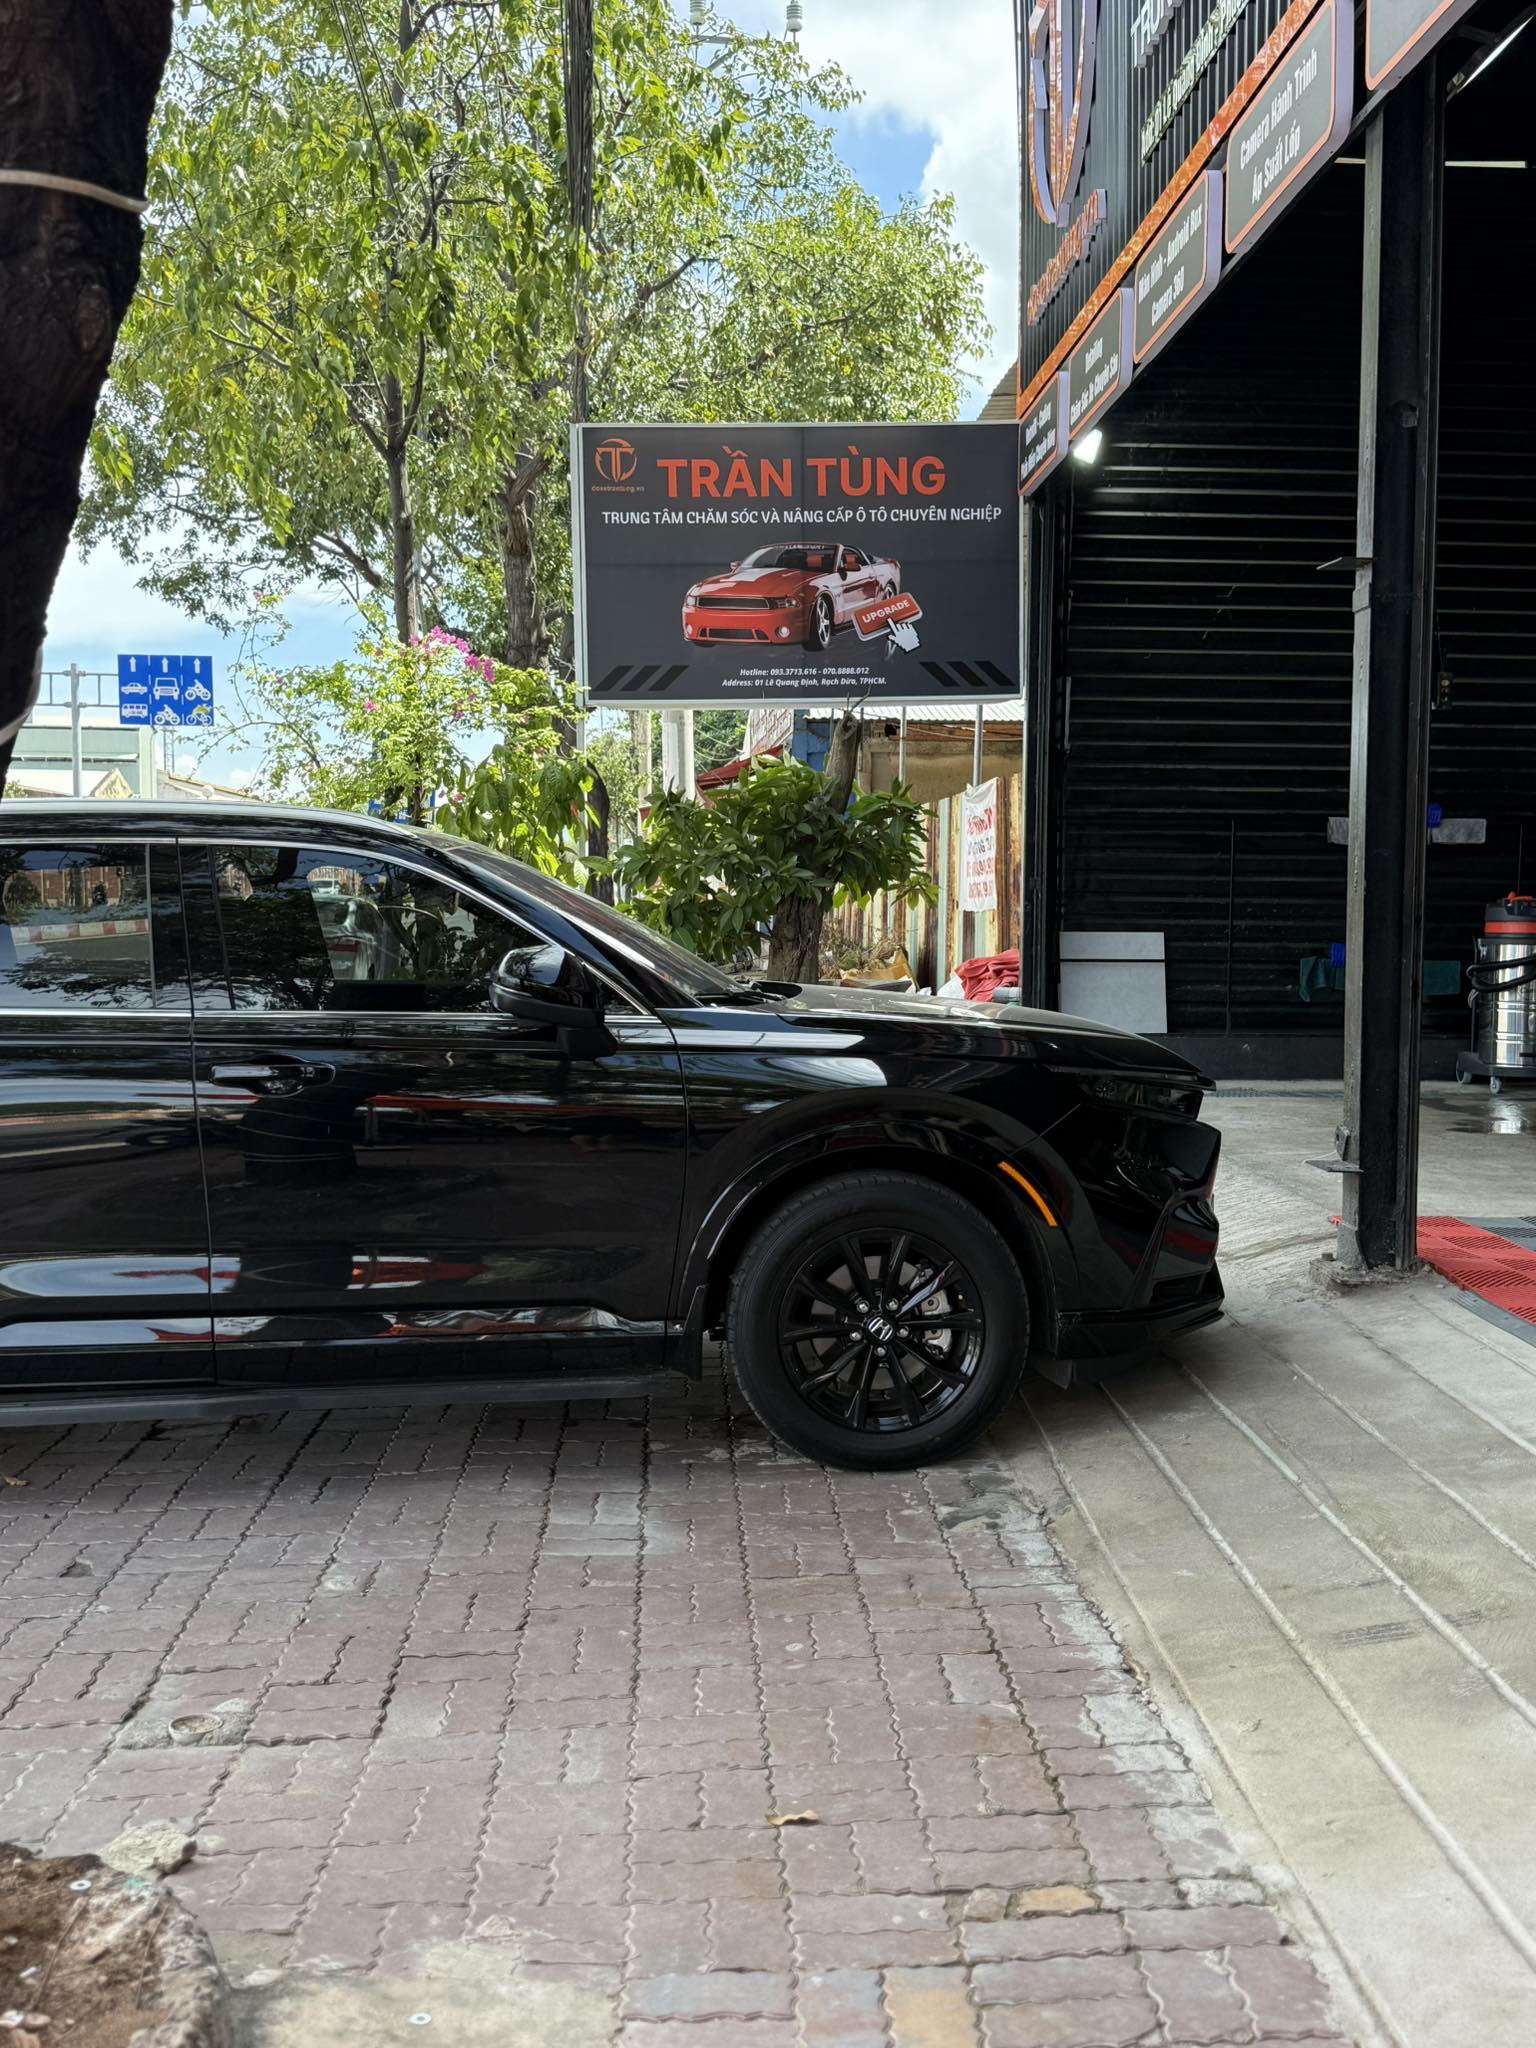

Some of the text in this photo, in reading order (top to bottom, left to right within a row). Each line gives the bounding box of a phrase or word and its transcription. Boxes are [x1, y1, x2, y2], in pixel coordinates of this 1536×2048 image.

[1240, 48, 1317, 170] Camera Hành Trình
[1252, 119, 1300, 204] Áp Suất Lốp
[1167, 216, 1190, 267] Android
[1190, 203, 1202, 236] Box
[1152, 266, 1184, 326] Camera 360
[656, 445, 946, 498] TRẦN TÙNG
[602, 504, 1002, 525] TRUNG TÂM CHĂM SÓC VÀ NÂNG CẤP Ô TÔ CHUYÊN NGHIỆP
[861, 600, 910, 623] UPGRADE
[722, 679, 753, 687] Address:
[765, 678, 774, 686] Lê
[775, 679, 799, 688] Quang
[800, 678, 819, 687] Định,
[821, 677, 839, 686] Rạch
[840, 677, 858, 686] Dừa,
[859, 676, 887, 685] TPHCM.
[740, 668, 769, 676] Hotline:
[770, 667, 817, 676] 093.3713.616
[823, 667, 870, 675] 070.8888.012
